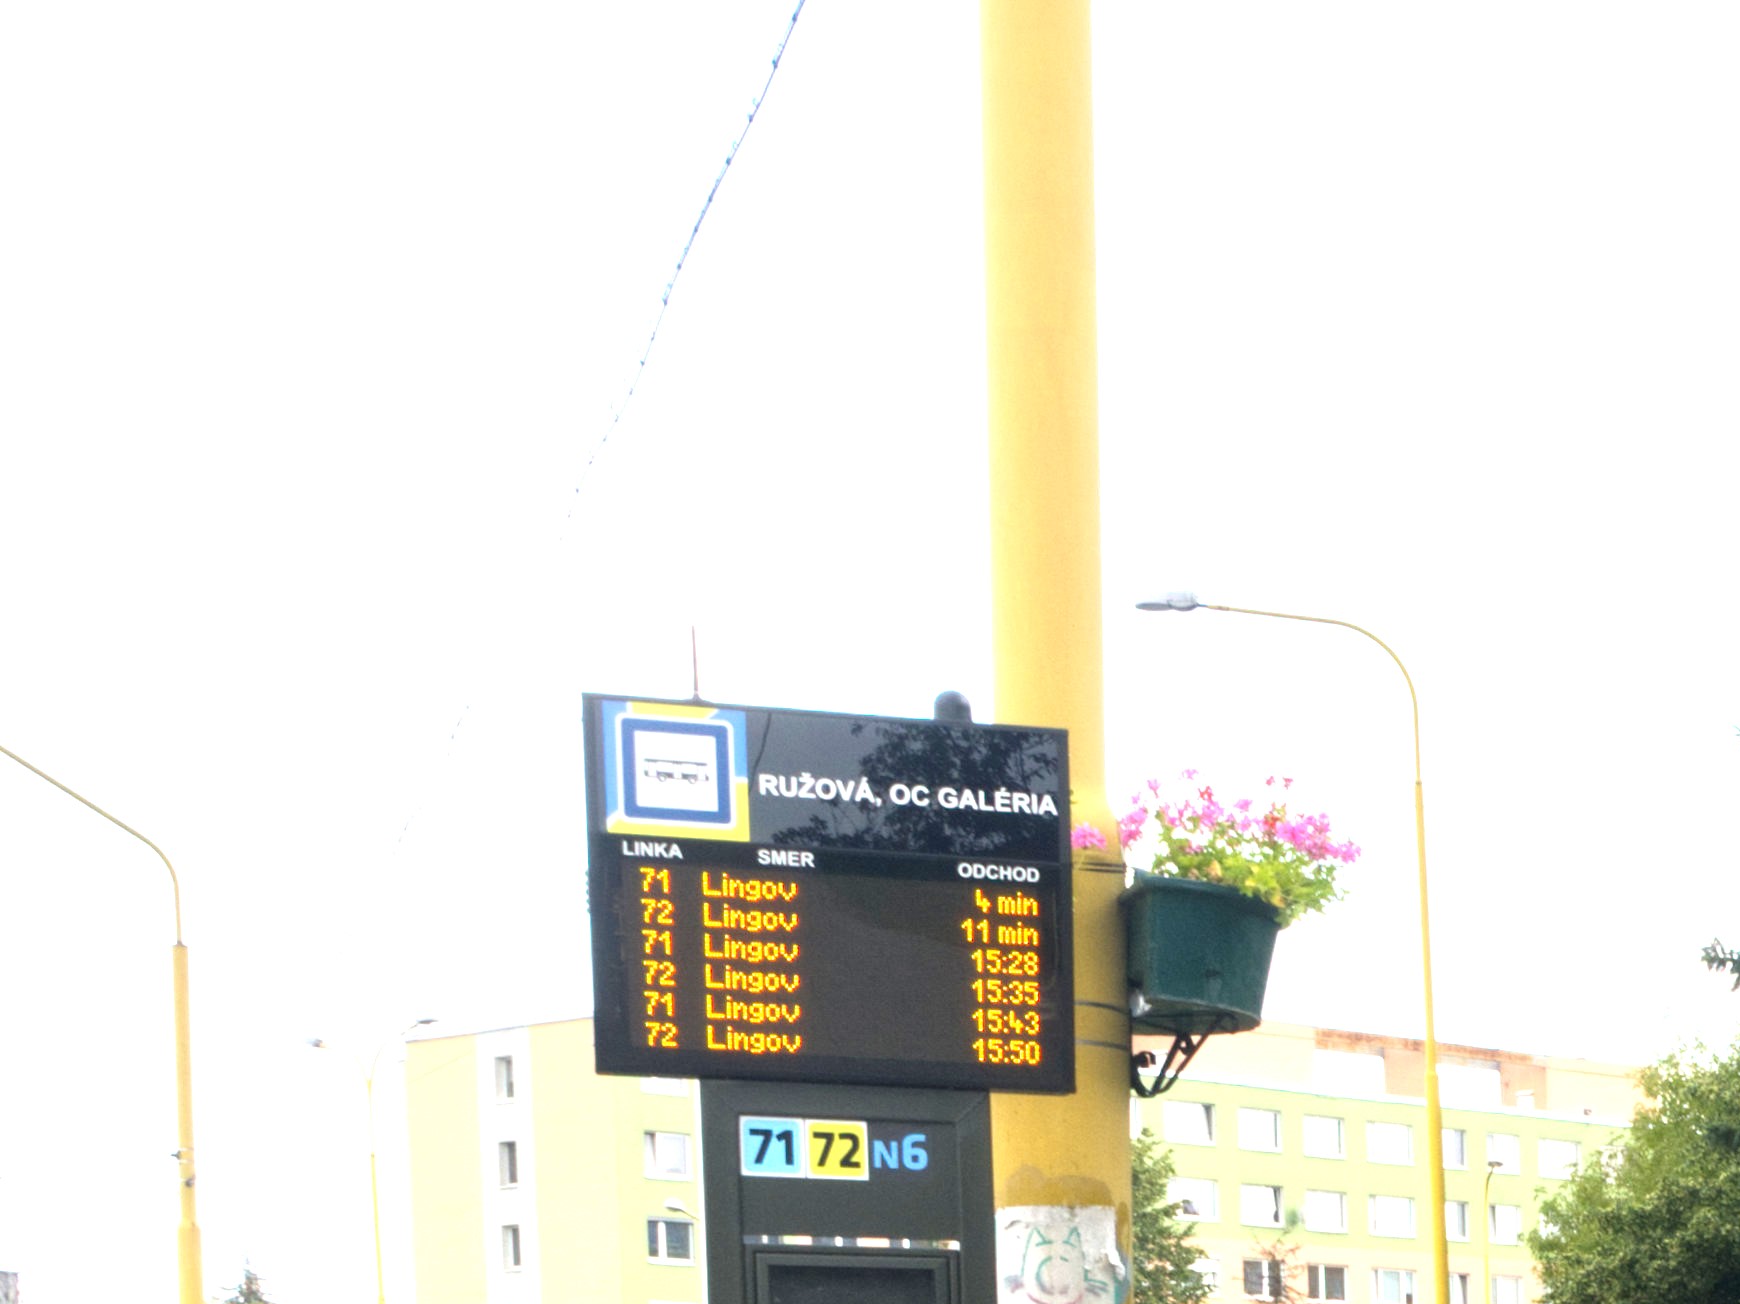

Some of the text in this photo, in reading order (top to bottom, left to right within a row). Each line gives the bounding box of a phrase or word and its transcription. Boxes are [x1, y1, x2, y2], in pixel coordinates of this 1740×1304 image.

[758, 772, 1058, 815] RUŽOVÁ, OC GALÉRIA
[622, 841, 1040, 882] LINKA SMER ODCHOD
[640, 867, 1039, 916] 71 Lingov 4 min
[641, 898, 1039, 946] 72 Lingov 11 min
[642, 928, 1040, 976] 71 Lingov 15:28
[643, 960, 1040, 1006] 72 Lingov 15:35
[644, 990, 1040, 1036] 71 Lingov 15:43
[646, 1021, 1042, 1066] 72 Lingov 15:50
[750, 1129, 928, 1171] 71 72 N6
